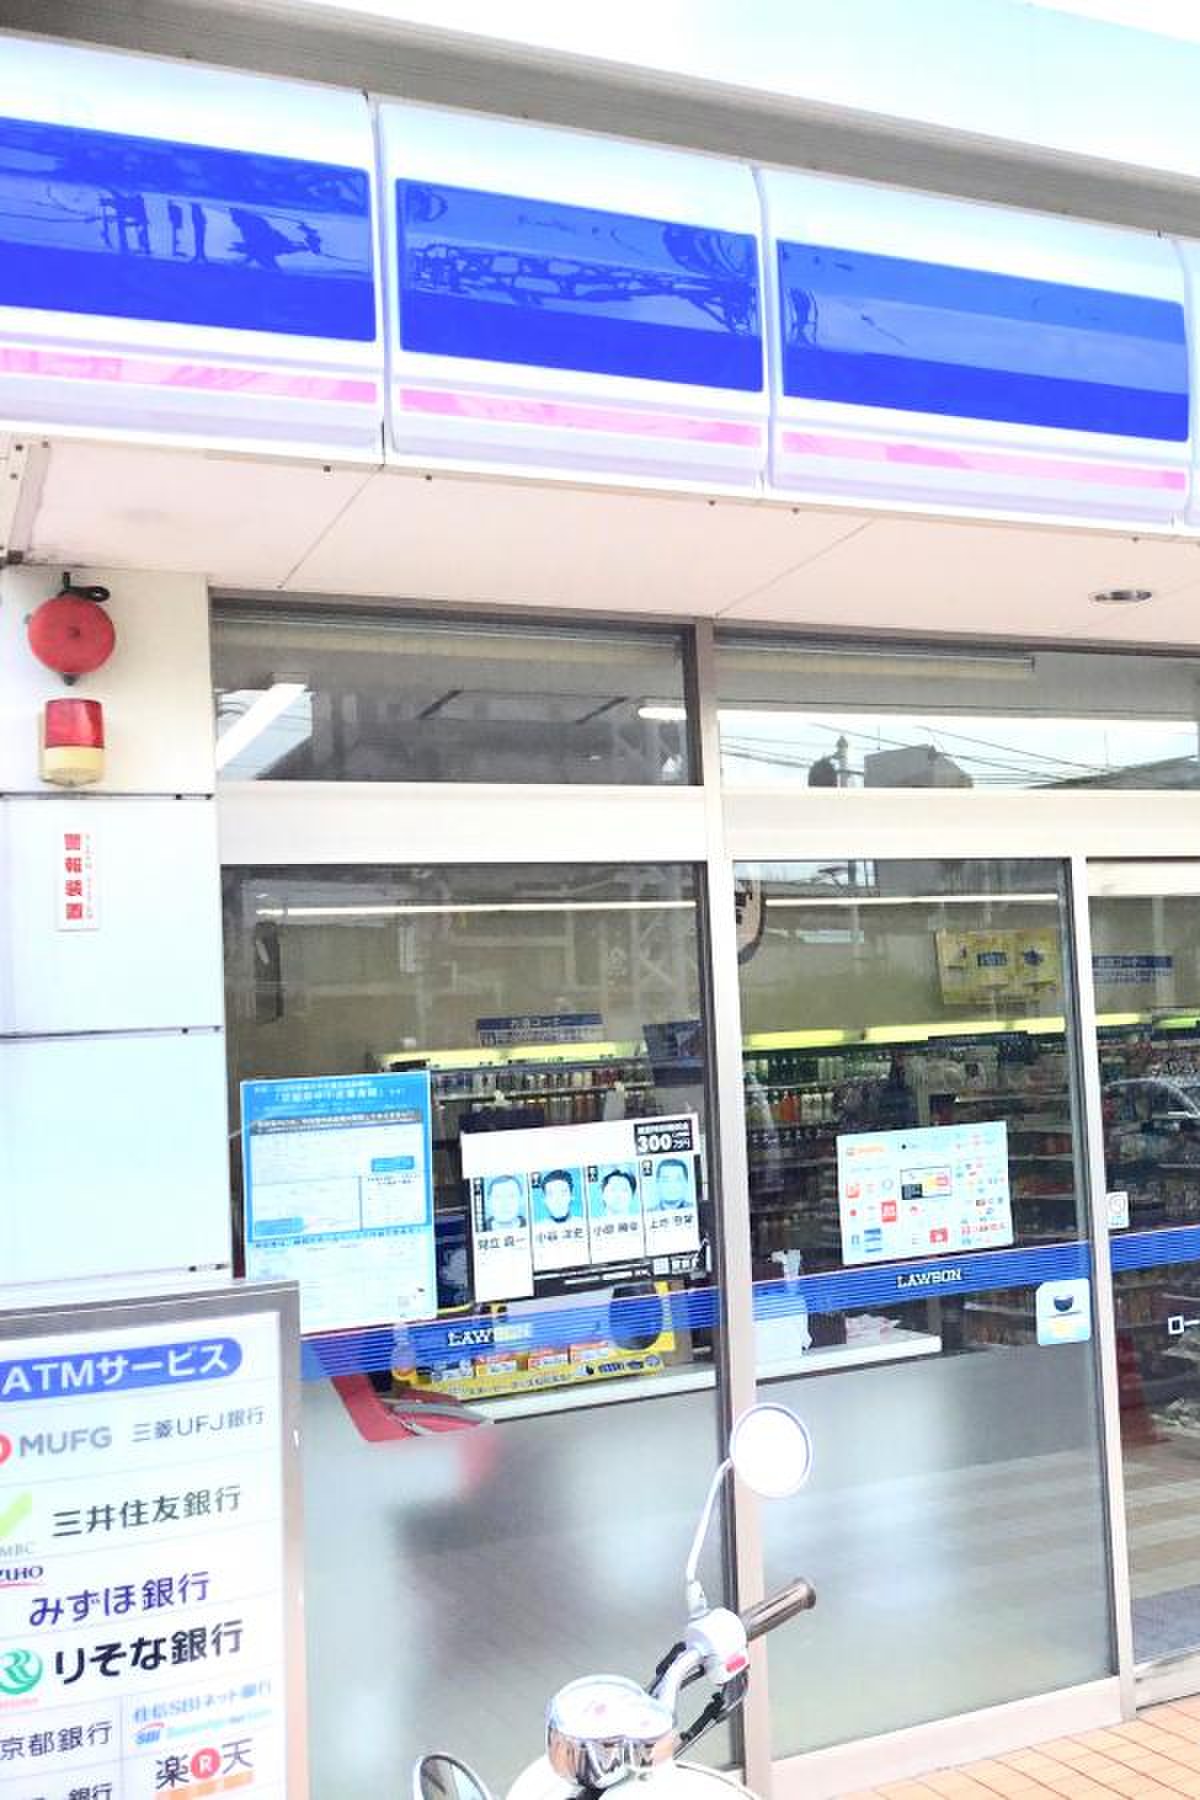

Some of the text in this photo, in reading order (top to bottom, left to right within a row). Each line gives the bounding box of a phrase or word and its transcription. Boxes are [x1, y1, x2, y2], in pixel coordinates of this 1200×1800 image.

[896, 1268, 962, 1289] LAWSON
[1, 1343, 229, 1396] ATMサービス
[19, 1425, 112, 1458] MUFG
[52, 1484, 241, 1537] 三井住友銀行
[29, 1570, 209, 1627] みずほ銀行
[55, 1619, 244, 1685] りそな銀行
